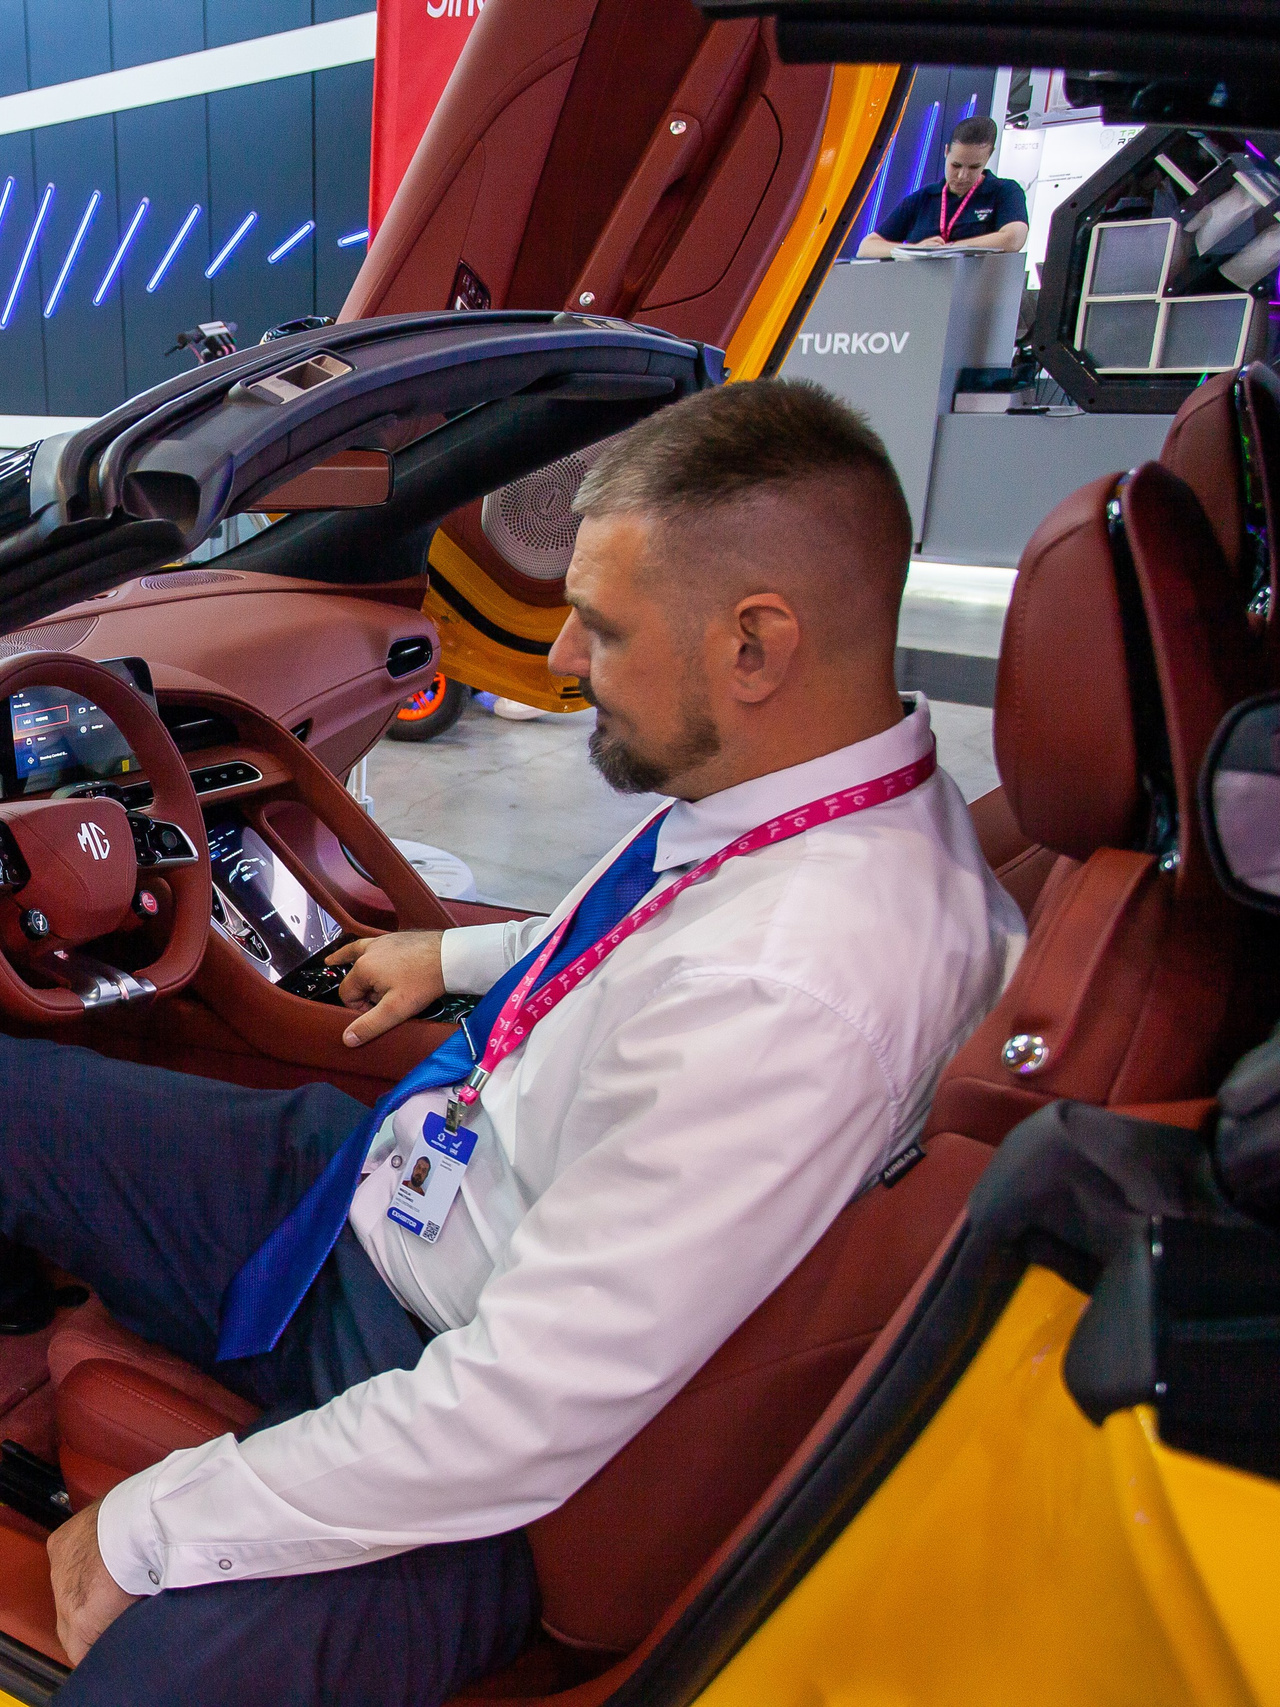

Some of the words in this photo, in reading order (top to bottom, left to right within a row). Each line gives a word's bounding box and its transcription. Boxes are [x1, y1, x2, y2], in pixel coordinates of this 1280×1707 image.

[798, 331, 910, 355] TURKOV
[76, 822, 111, 861] MG
[884, 1148, 917, 1180] AIRBAG
